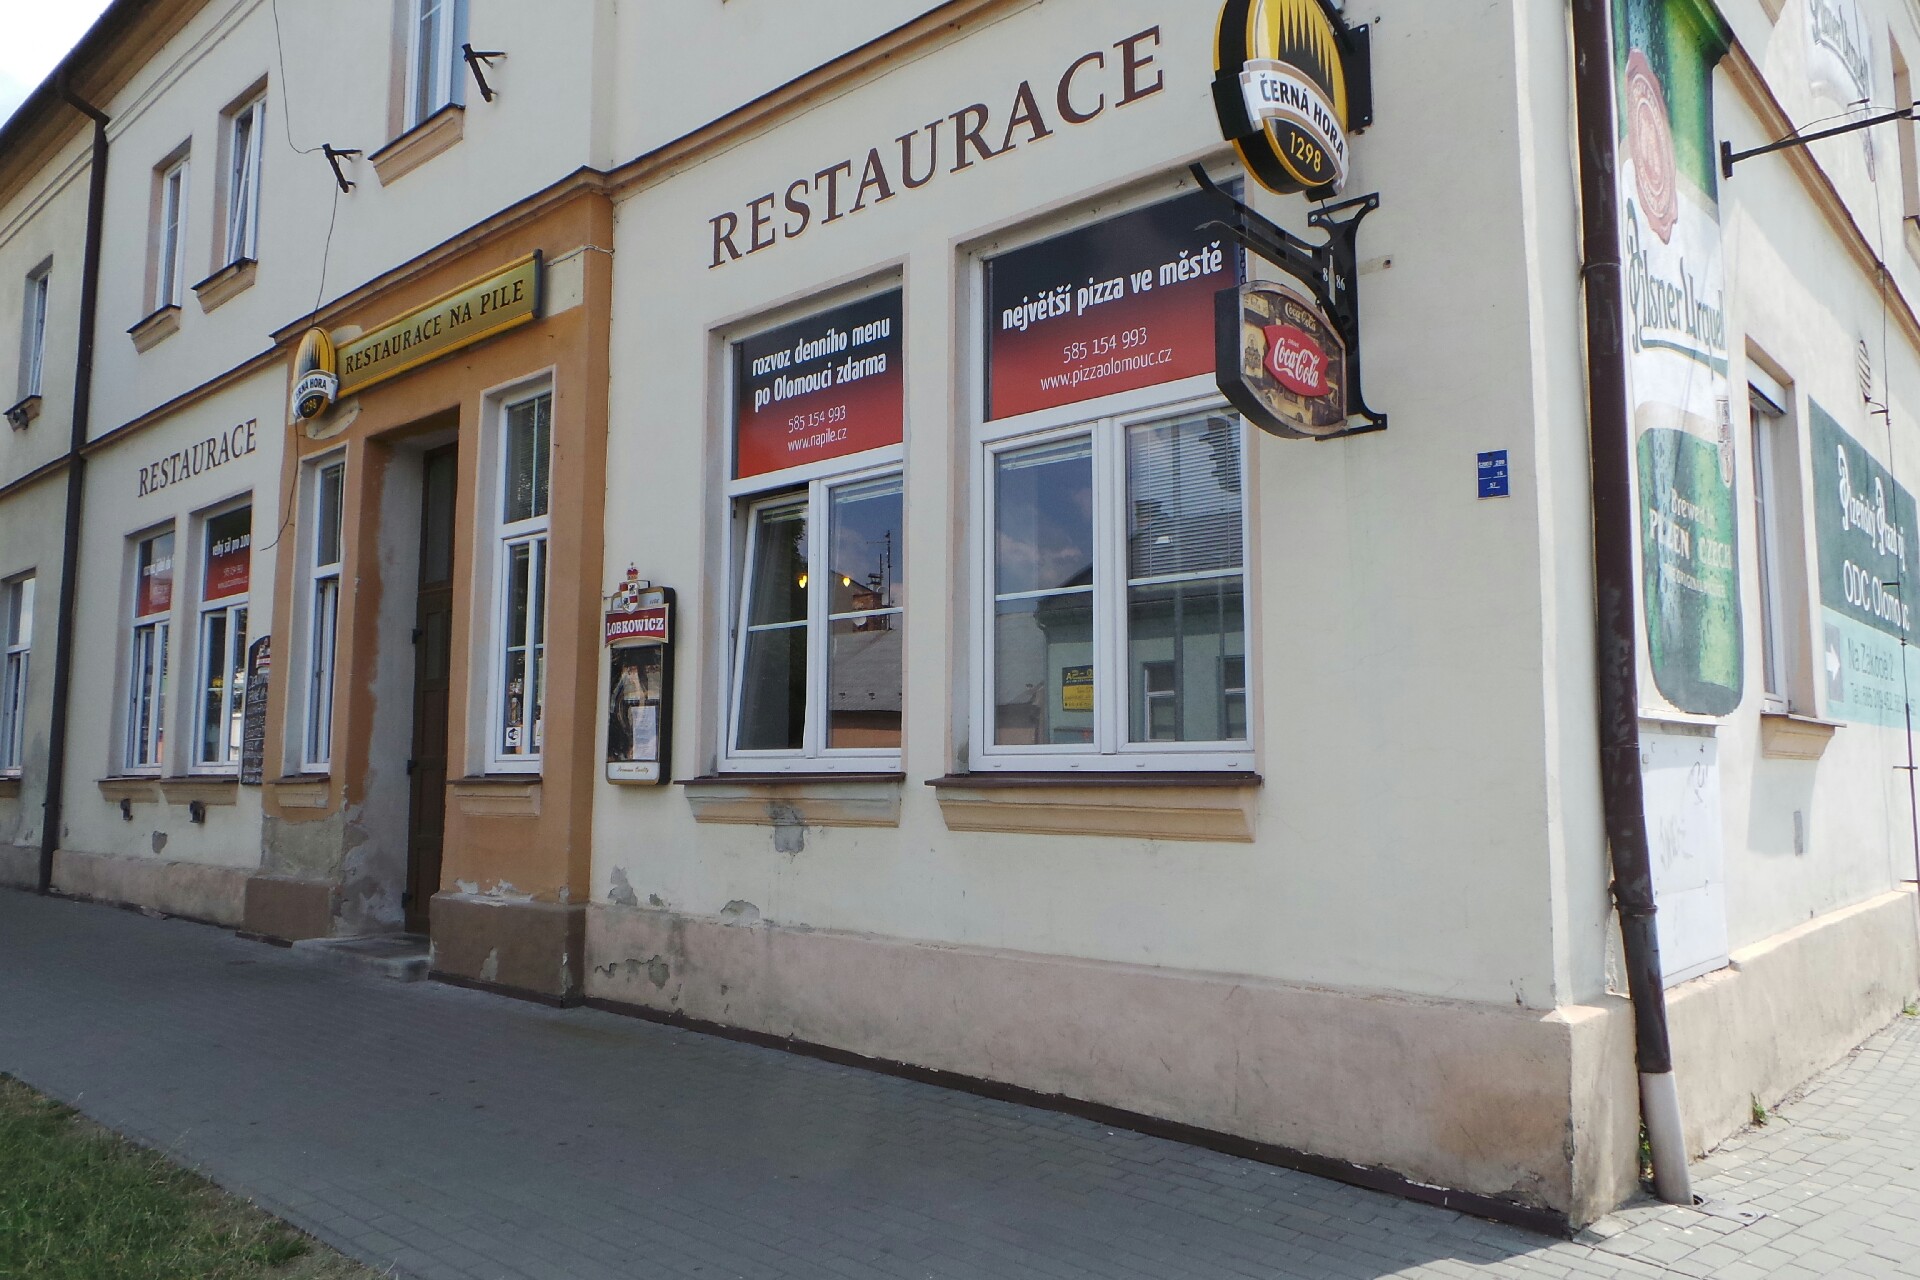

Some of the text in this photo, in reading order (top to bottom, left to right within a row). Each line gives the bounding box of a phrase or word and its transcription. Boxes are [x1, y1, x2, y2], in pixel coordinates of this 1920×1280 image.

[1259, 73, 1344, 161] ČERNÁ HORA
[708, 25, 1164, 269] RESTAURACE
[1290, 131, 1322, 172] 1298
[1002, 240, 1223, 331] největší pizza ve městě
[1627, 198, 1683, 353] Pilsner
[345, 279, 524, 375] RESTAURACE NA PILE
[752, 317, 890, 377] rozvoz denního menu
[1063, 327, 1147, 364] 585 154 993
[309, 377, 327, 390] HORA
[755, 353, 887, 413] po Olomouci zdarma
[1040, 348, 1172, 391] www.pizzaolomouc.cz
[787, 427, 847, 451] www.napile.cz
[788, 405, 846, 433] 585 154 993
[138, 418, 257, 498] RESTAURACE
[1843, 560, 1870, 611] ODC
[607, 617, 665, 636] LOBKOWICZ
